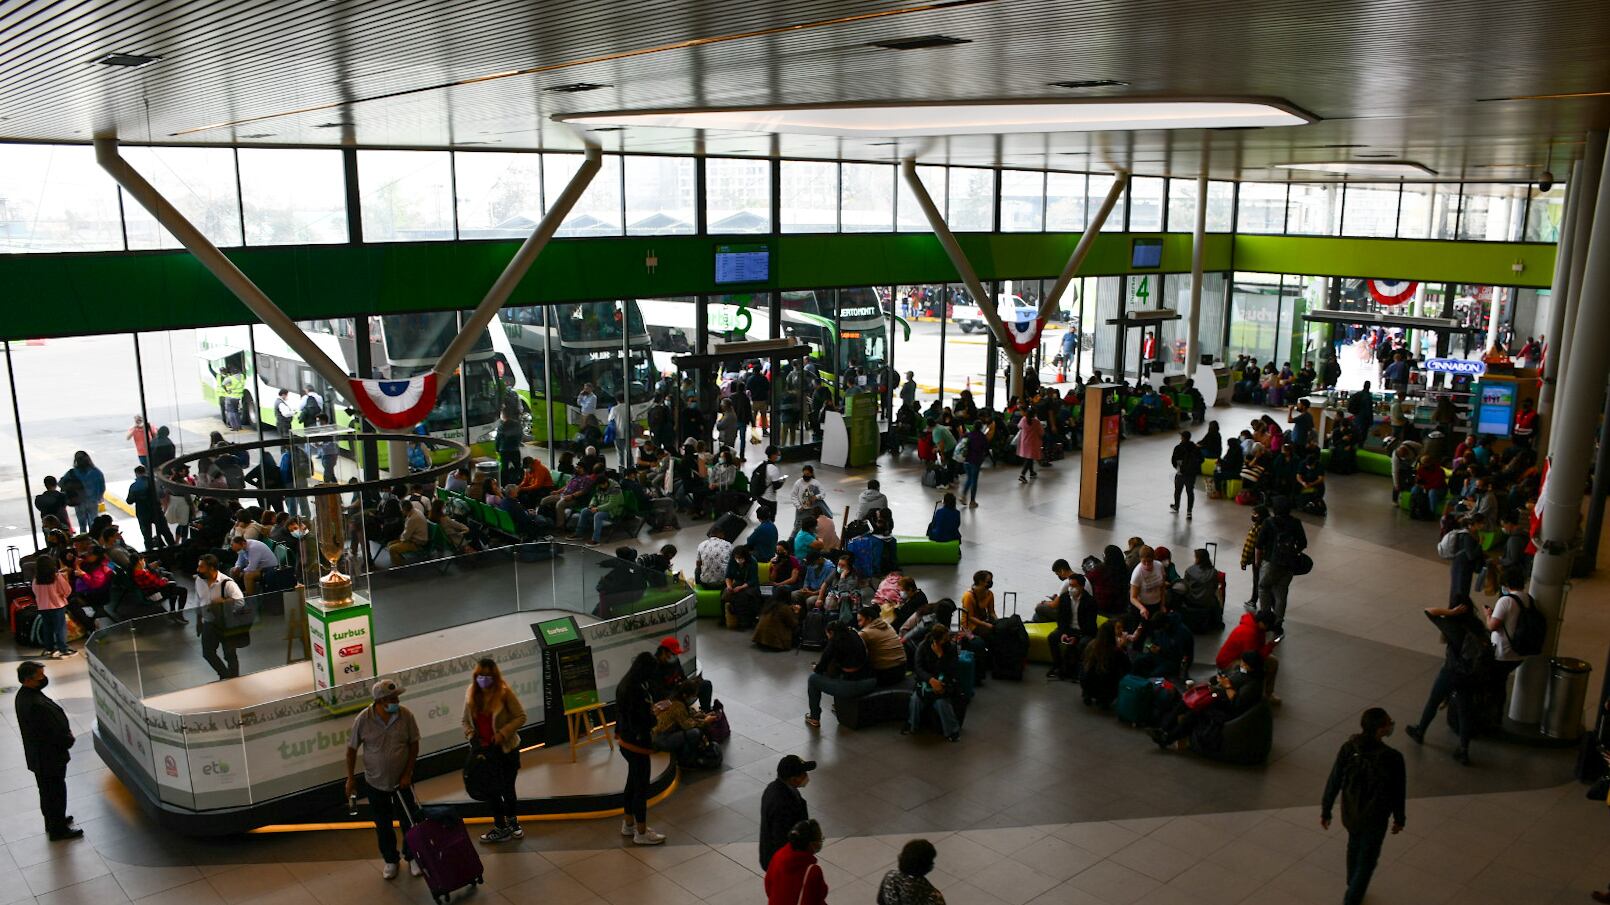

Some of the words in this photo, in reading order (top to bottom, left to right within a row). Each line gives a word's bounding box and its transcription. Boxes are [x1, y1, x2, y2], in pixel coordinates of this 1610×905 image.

[1136, 275, 1149, 304] 4
[1427, 360, 1480, 373] CINNABON
[333, 628, 366, 640] turbus
[546, 627, 568, 635] turbus
